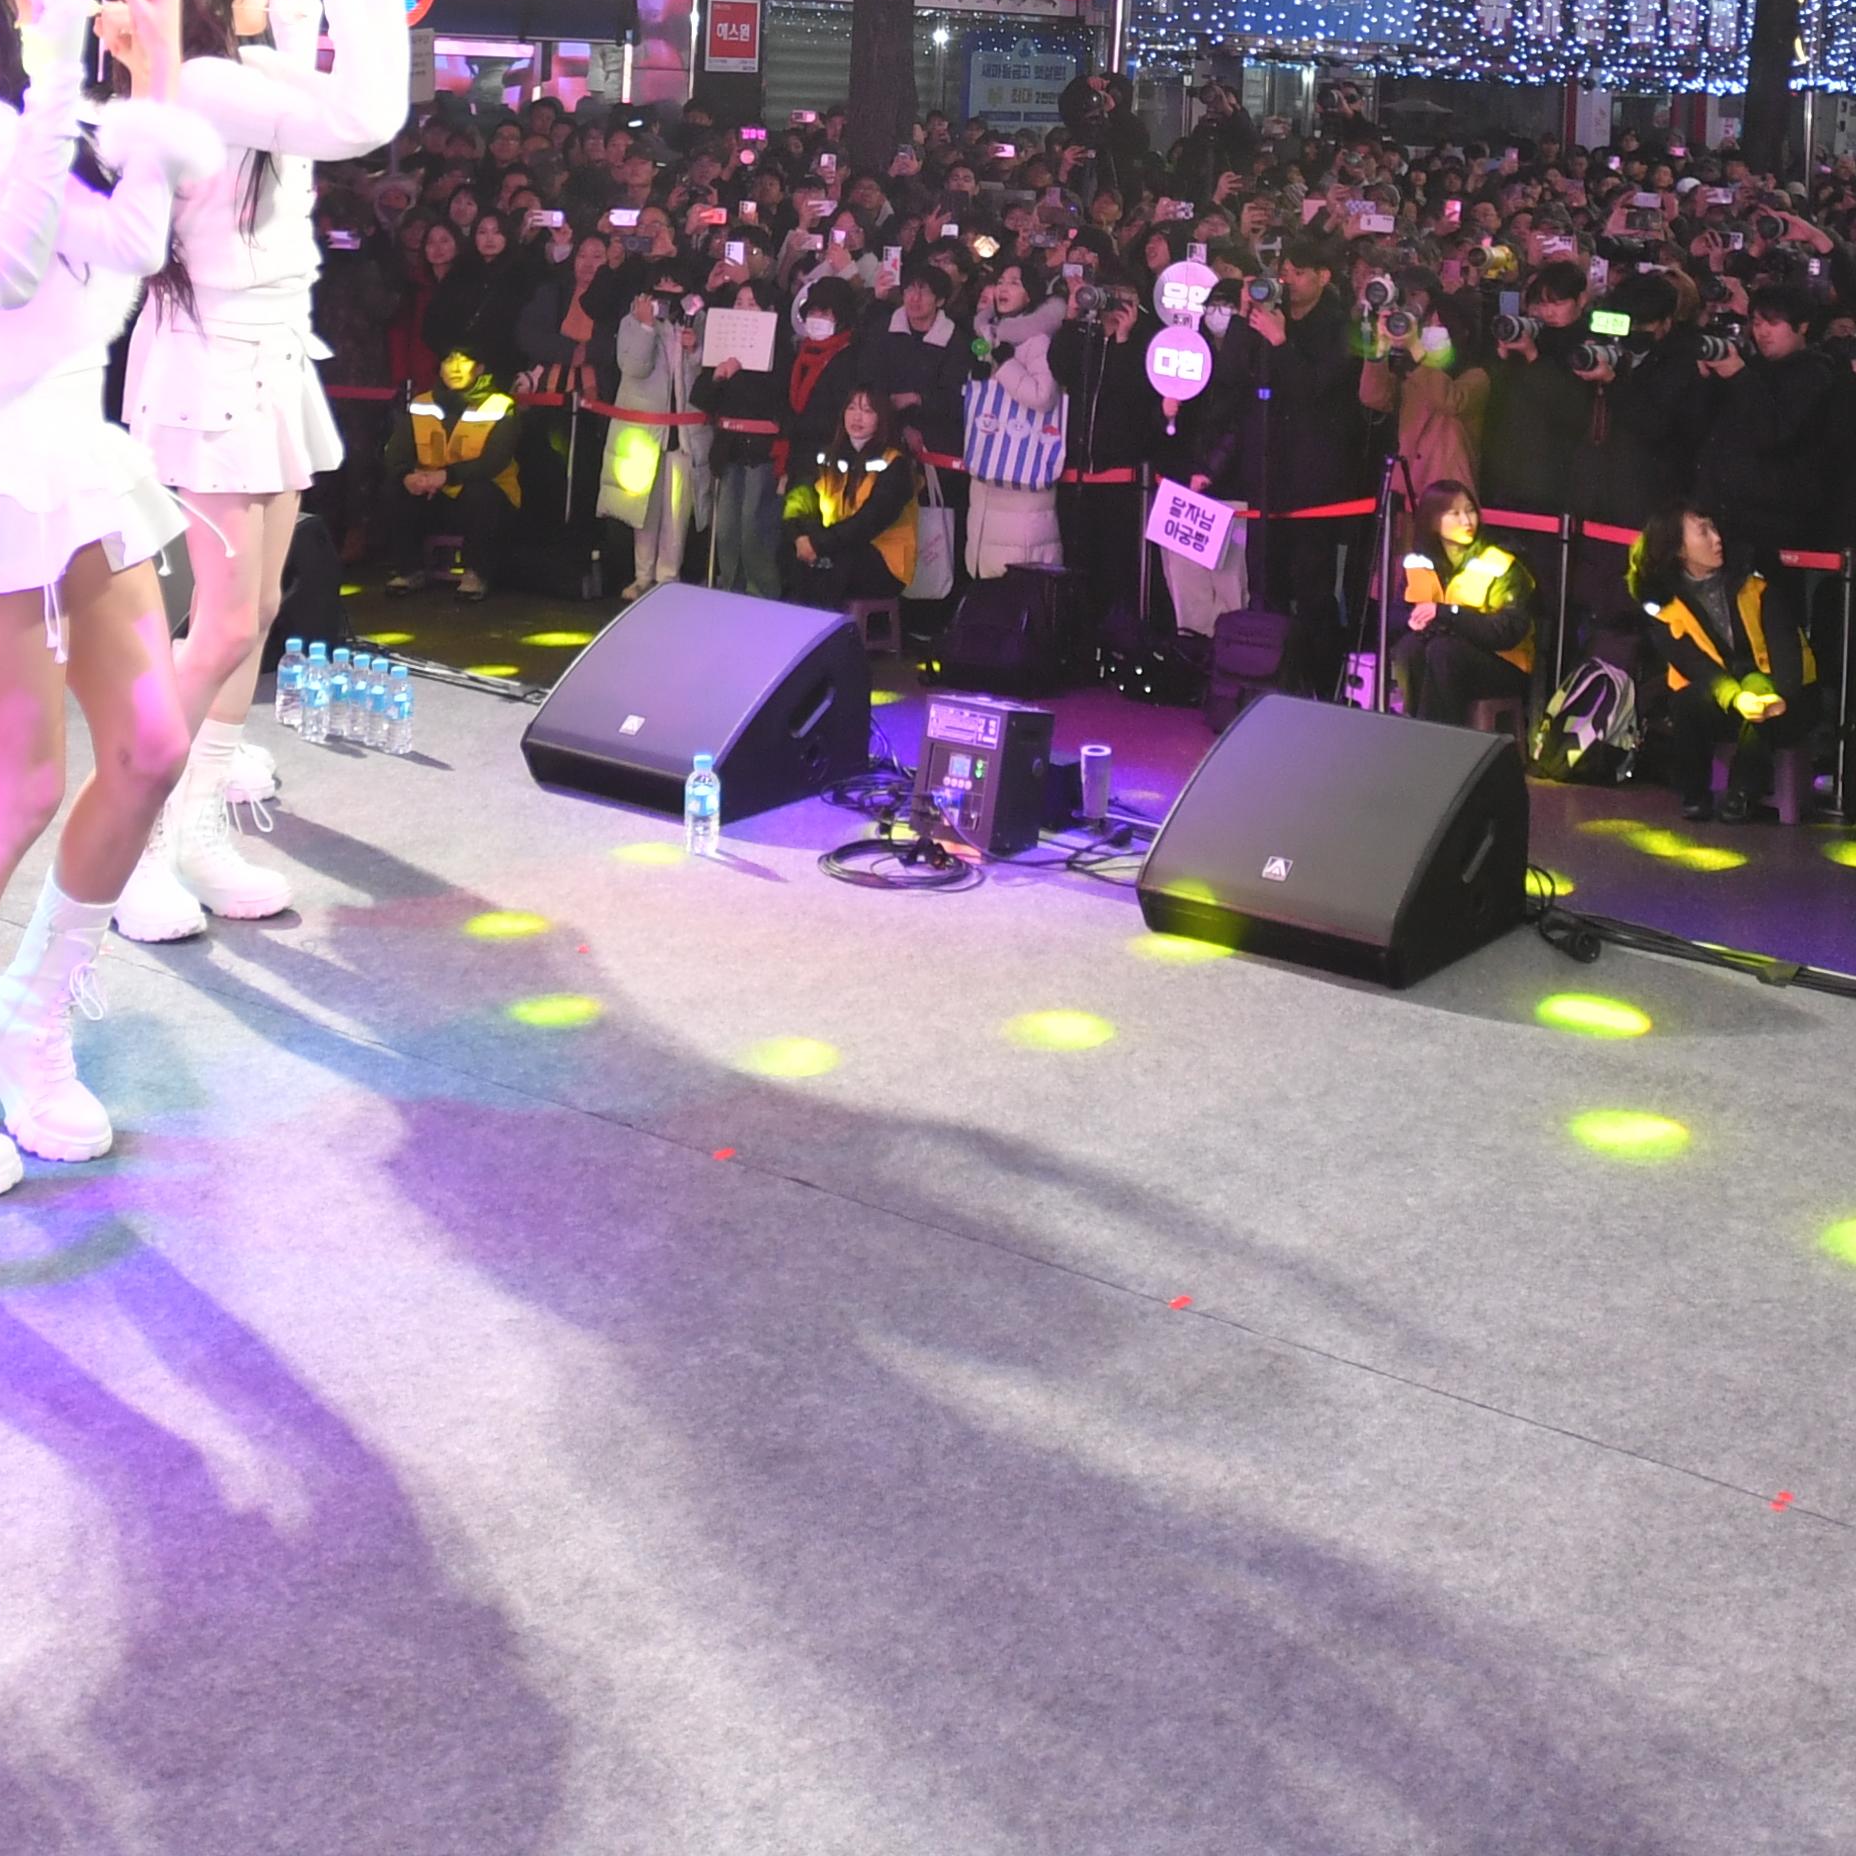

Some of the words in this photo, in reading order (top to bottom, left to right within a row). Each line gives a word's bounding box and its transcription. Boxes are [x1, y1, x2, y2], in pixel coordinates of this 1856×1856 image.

[717, 22, 750, 42] 에스원
[982, 63, 1031, 79] 새마을금고
[1170, 496, 1216, 532] 달자님
[1164, 519, 1210, 553] 아궁빵
